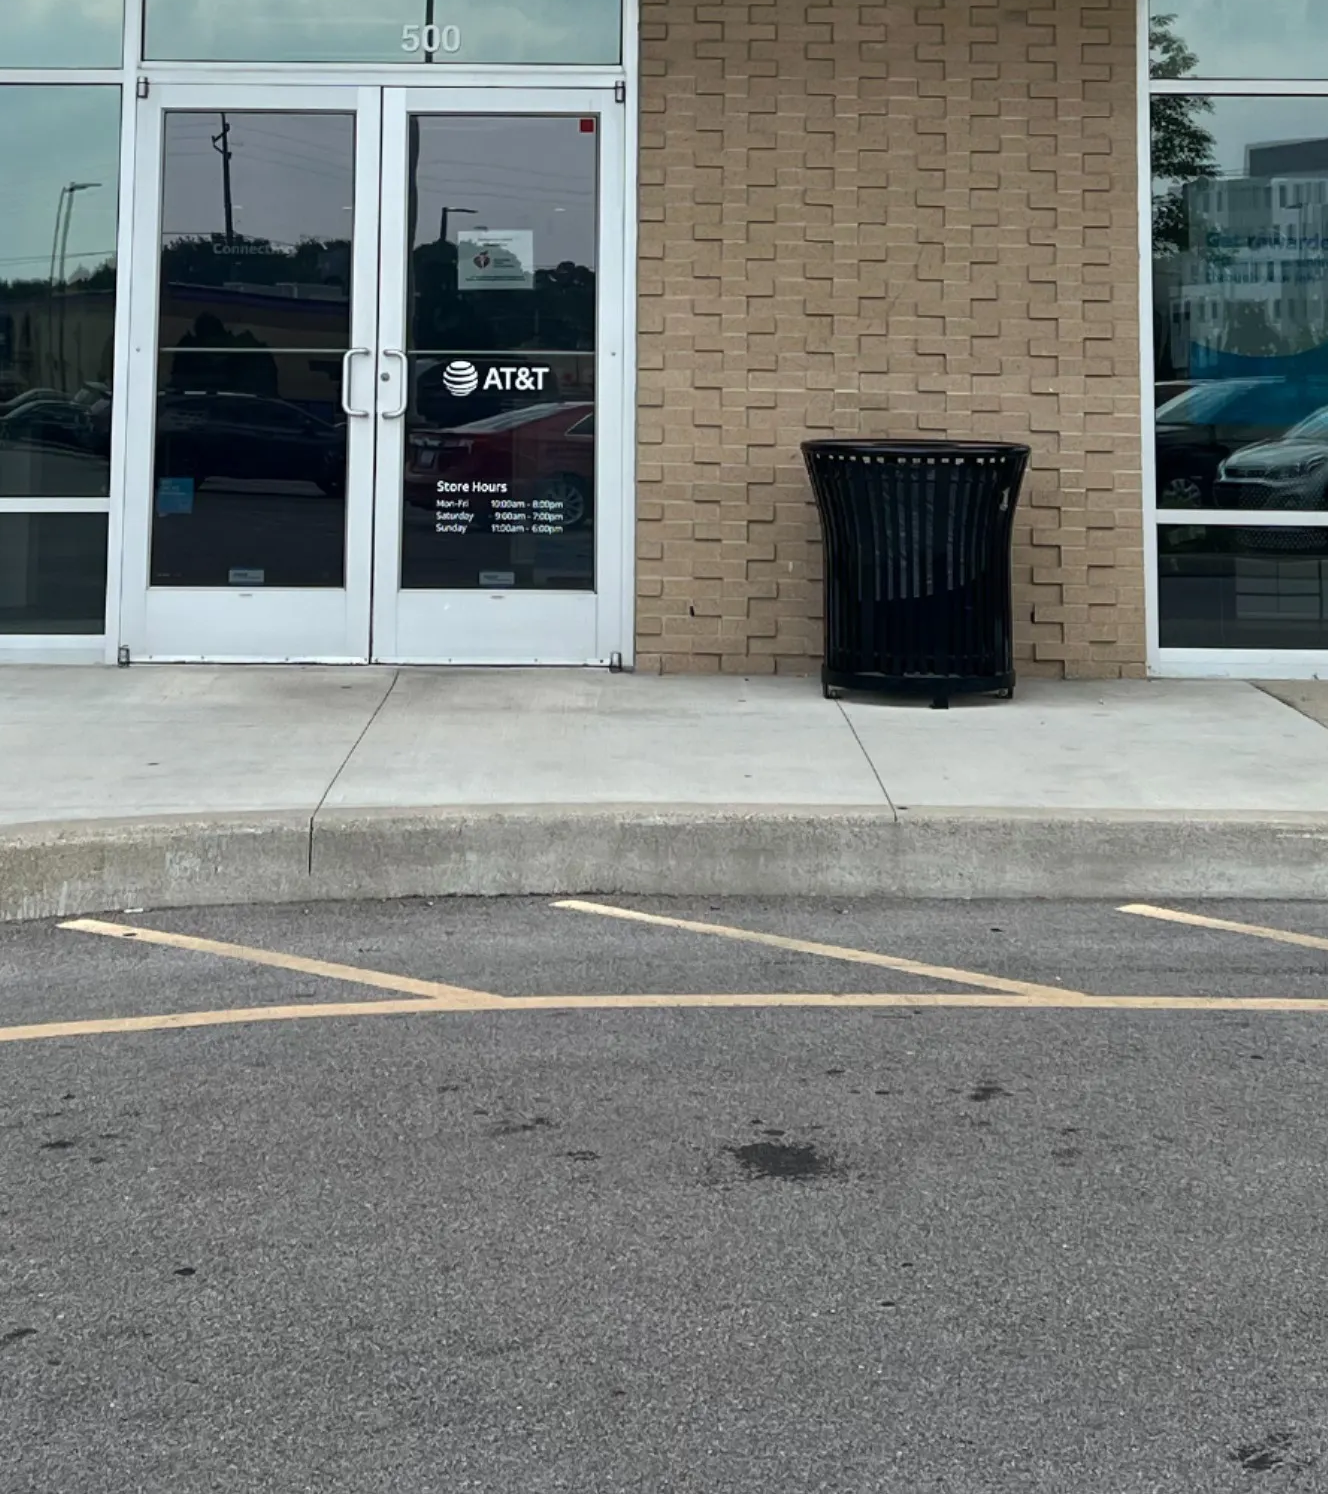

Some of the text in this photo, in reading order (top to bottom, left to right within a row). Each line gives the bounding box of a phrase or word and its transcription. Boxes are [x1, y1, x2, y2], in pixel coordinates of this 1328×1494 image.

[401, 25, 461, 53] 500
[213, 243, 296, 258] Connectg
[483, 367, 550, 391] AT&T
[436, 480, 508, 493] Store Hours
[436, 499, 470, 508] Mon-Fri
[436, 511, 474, 523] Saturday
[435, 523, 468, 535] Sunday
